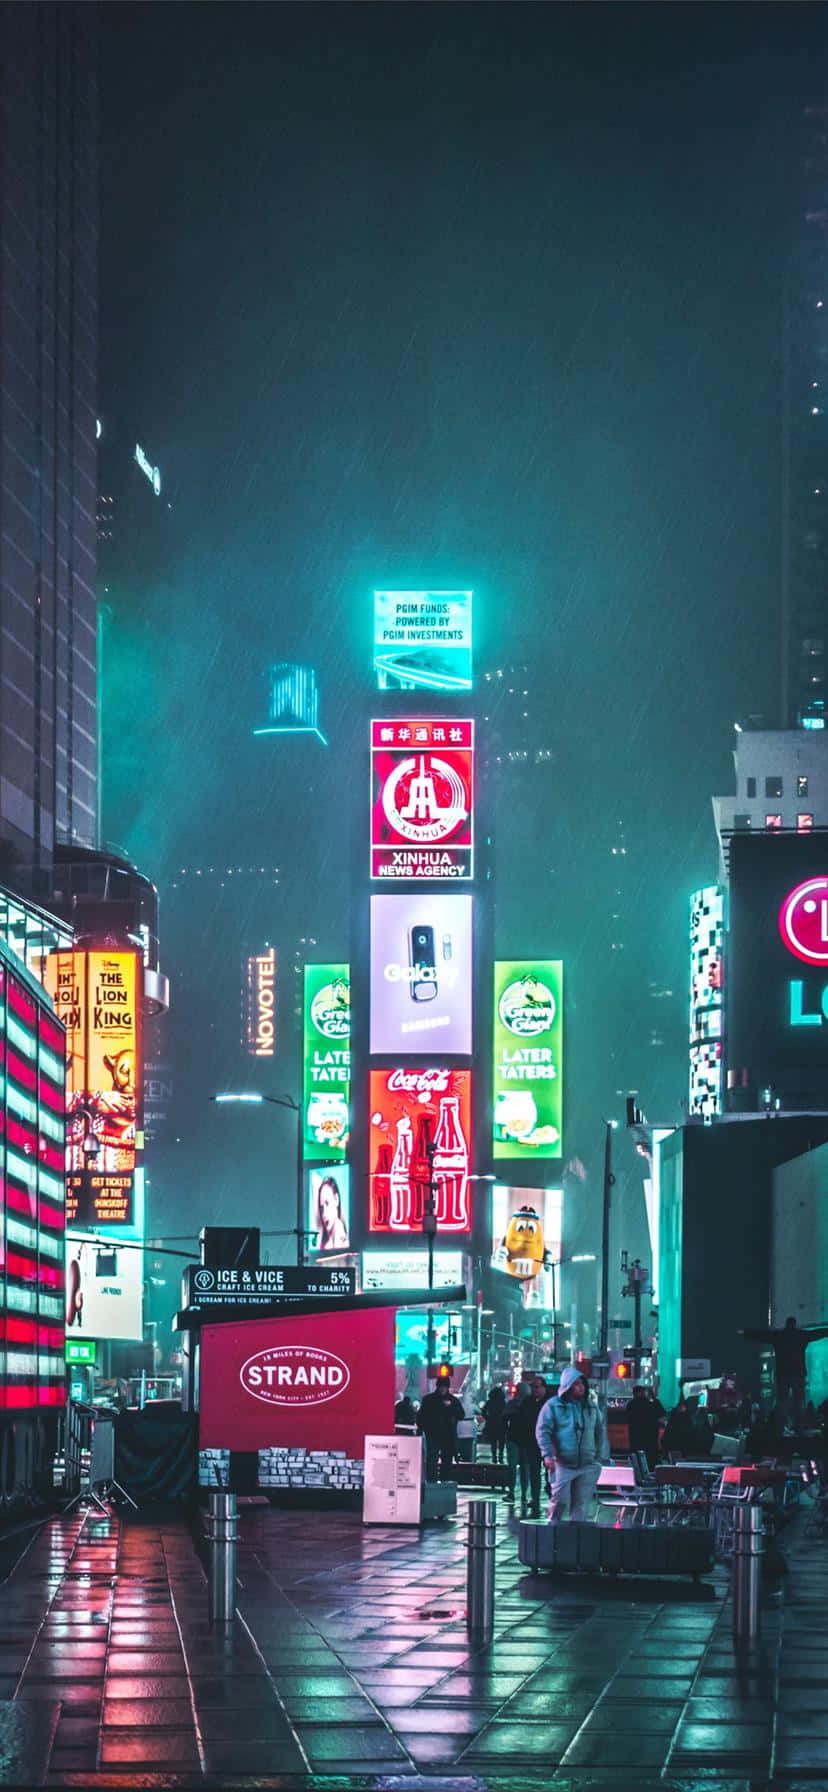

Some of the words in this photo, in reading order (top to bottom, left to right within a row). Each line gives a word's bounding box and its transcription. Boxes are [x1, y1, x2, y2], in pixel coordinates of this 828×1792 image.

[396, 603, 418, 614] PGIM
[395, 616, 436, 627] POWERED
[438, 616, 450, 627] BY
[383, 630, 405, 640] PGIM
[407, 630, 464, 640] INVESTMENTS
[380, 727, 463, 742] 新华通讯社
[400, 823, 447, 839] XINHUA
[392, 852, 452, 866] XINHUA
[378, 865, 414, 877] NEWS
[415, 865, 465, 877] AGENCY
[100, 972, 122, 984] THE
[384, 963, 459, 990] Galay
[96, 986, 128, 1006] LION
[256, 948, 275, 1056] NOVOTEL
[94, 1007, 132, 1029] KING
[502, 1047, 552, 1064] LATER
[498, 1064, 556, 1080] TATERS
[217, 1270, 238, 1283] ICE
[242, 1271, 251, 1283] &
[255, 1271, 285, 1284] VICE
[330, 1272, 350, 1284] 5%
[257, 1284, 284, 1292] CREAM
[319, 1285, 350, 1293] CHARITY
[248, 1365, 343, 1386] STRAND
